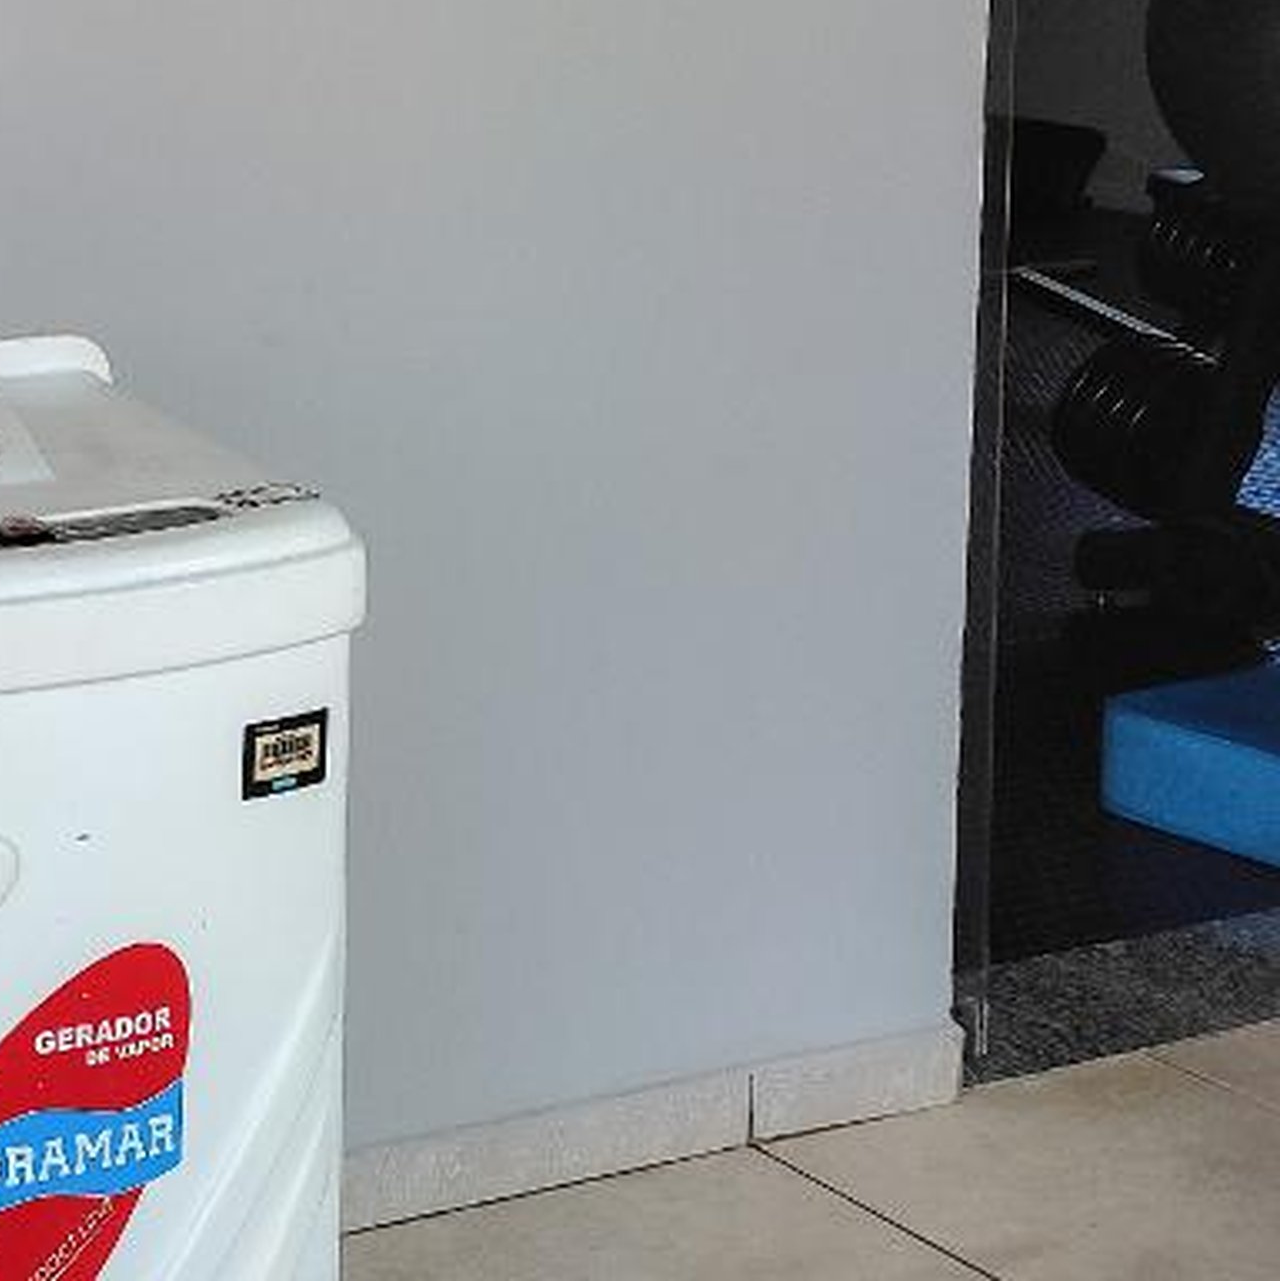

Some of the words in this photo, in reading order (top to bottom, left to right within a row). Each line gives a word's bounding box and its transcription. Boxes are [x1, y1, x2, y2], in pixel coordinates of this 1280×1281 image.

[34, 1006, 172, 1055] GERADOR
[85, 1046, 111, 1066] DE
[114, 1033, 175, 1060] VAPOR
